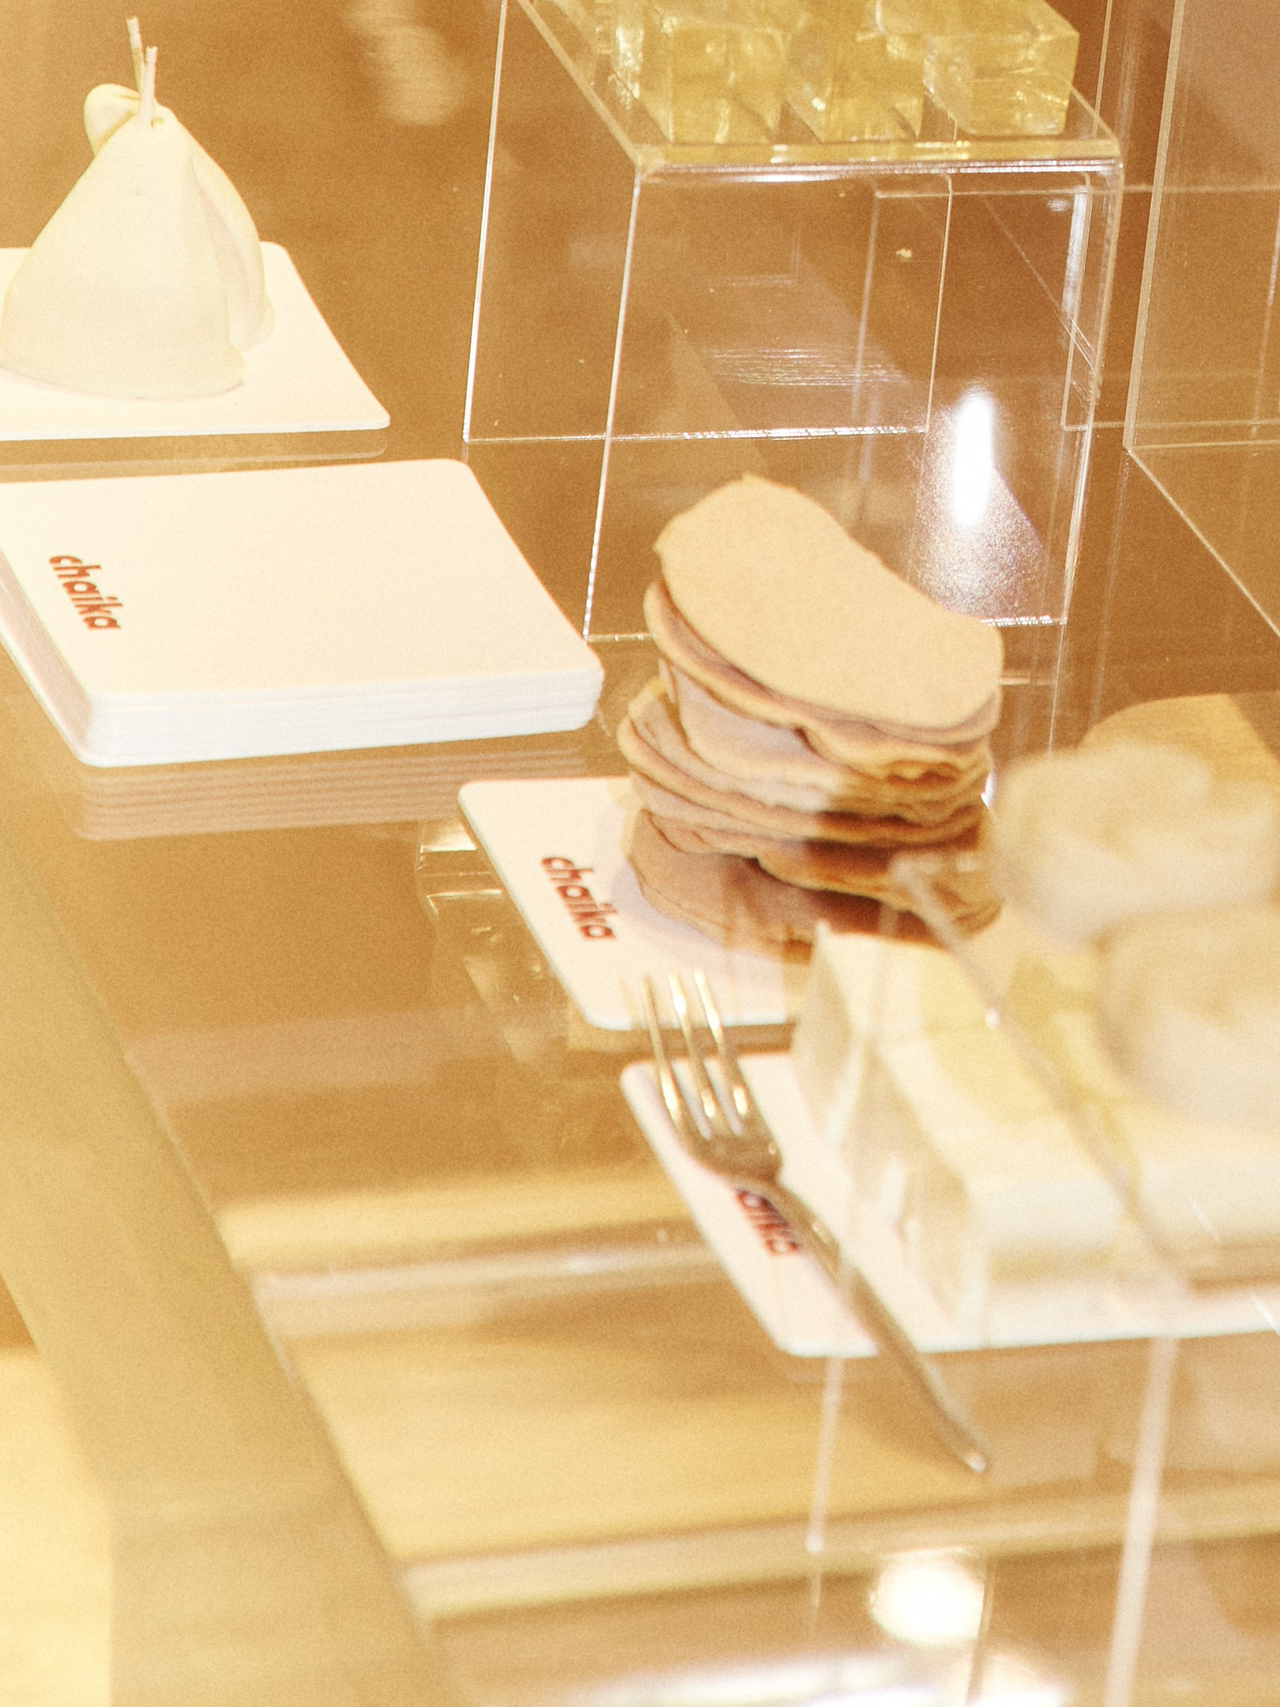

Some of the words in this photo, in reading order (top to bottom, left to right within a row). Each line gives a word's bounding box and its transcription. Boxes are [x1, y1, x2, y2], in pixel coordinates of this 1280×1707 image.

[48, 555, 123, 630] chaika
[540, 856, 619, 940] chaika
[736, 1190, 799, 1257] aika
